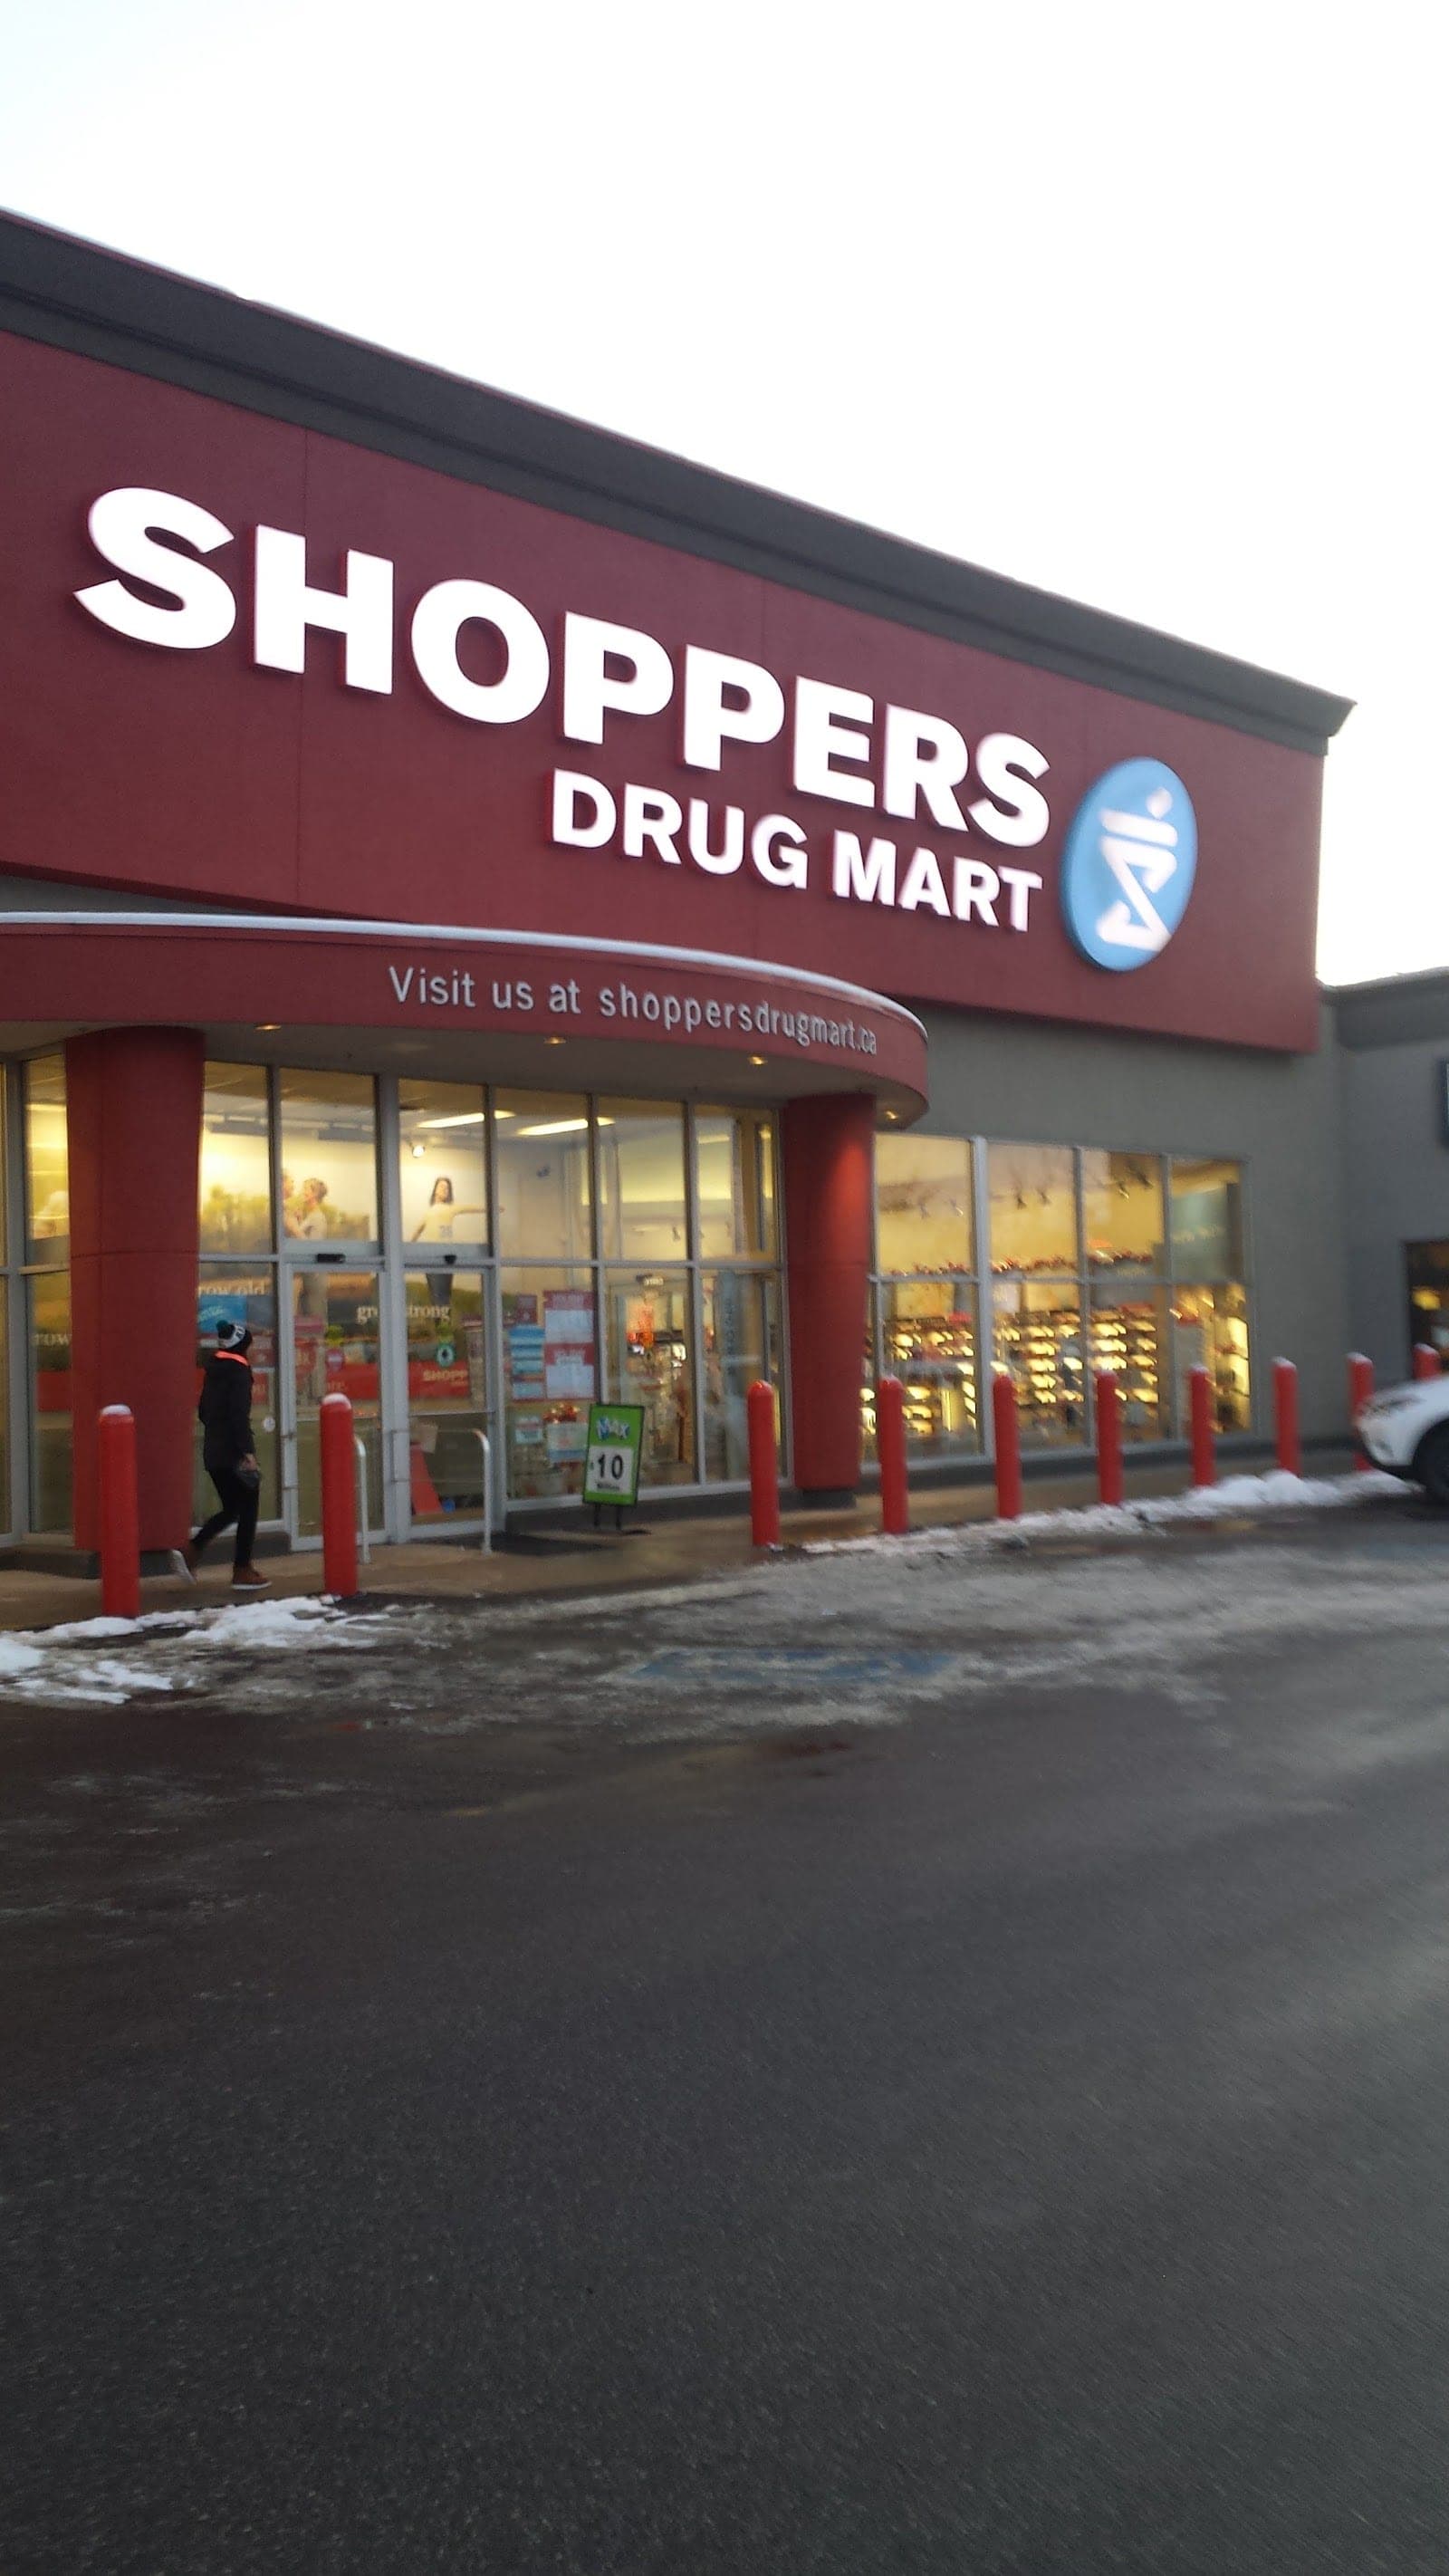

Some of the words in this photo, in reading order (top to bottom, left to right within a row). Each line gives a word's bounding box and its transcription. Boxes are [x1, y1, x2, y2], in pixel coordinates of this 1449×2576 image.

[73, 486, 1051, 848] SHOPPERS
[551, 767, 809, 890] DRUG
[830, 829, 1043, 932] MART
[389, 965, 476, 1008] Visit
[492, 981, 534, 1011] us
[548, 978, 581, 1014] at
[599, 981, 878, 1055] shoppersdrugmart.ca
[197, 1284, 229, 1297] row
[408, 1304, 451, 1323] trong
[34, 1332, 72, 1347] row
